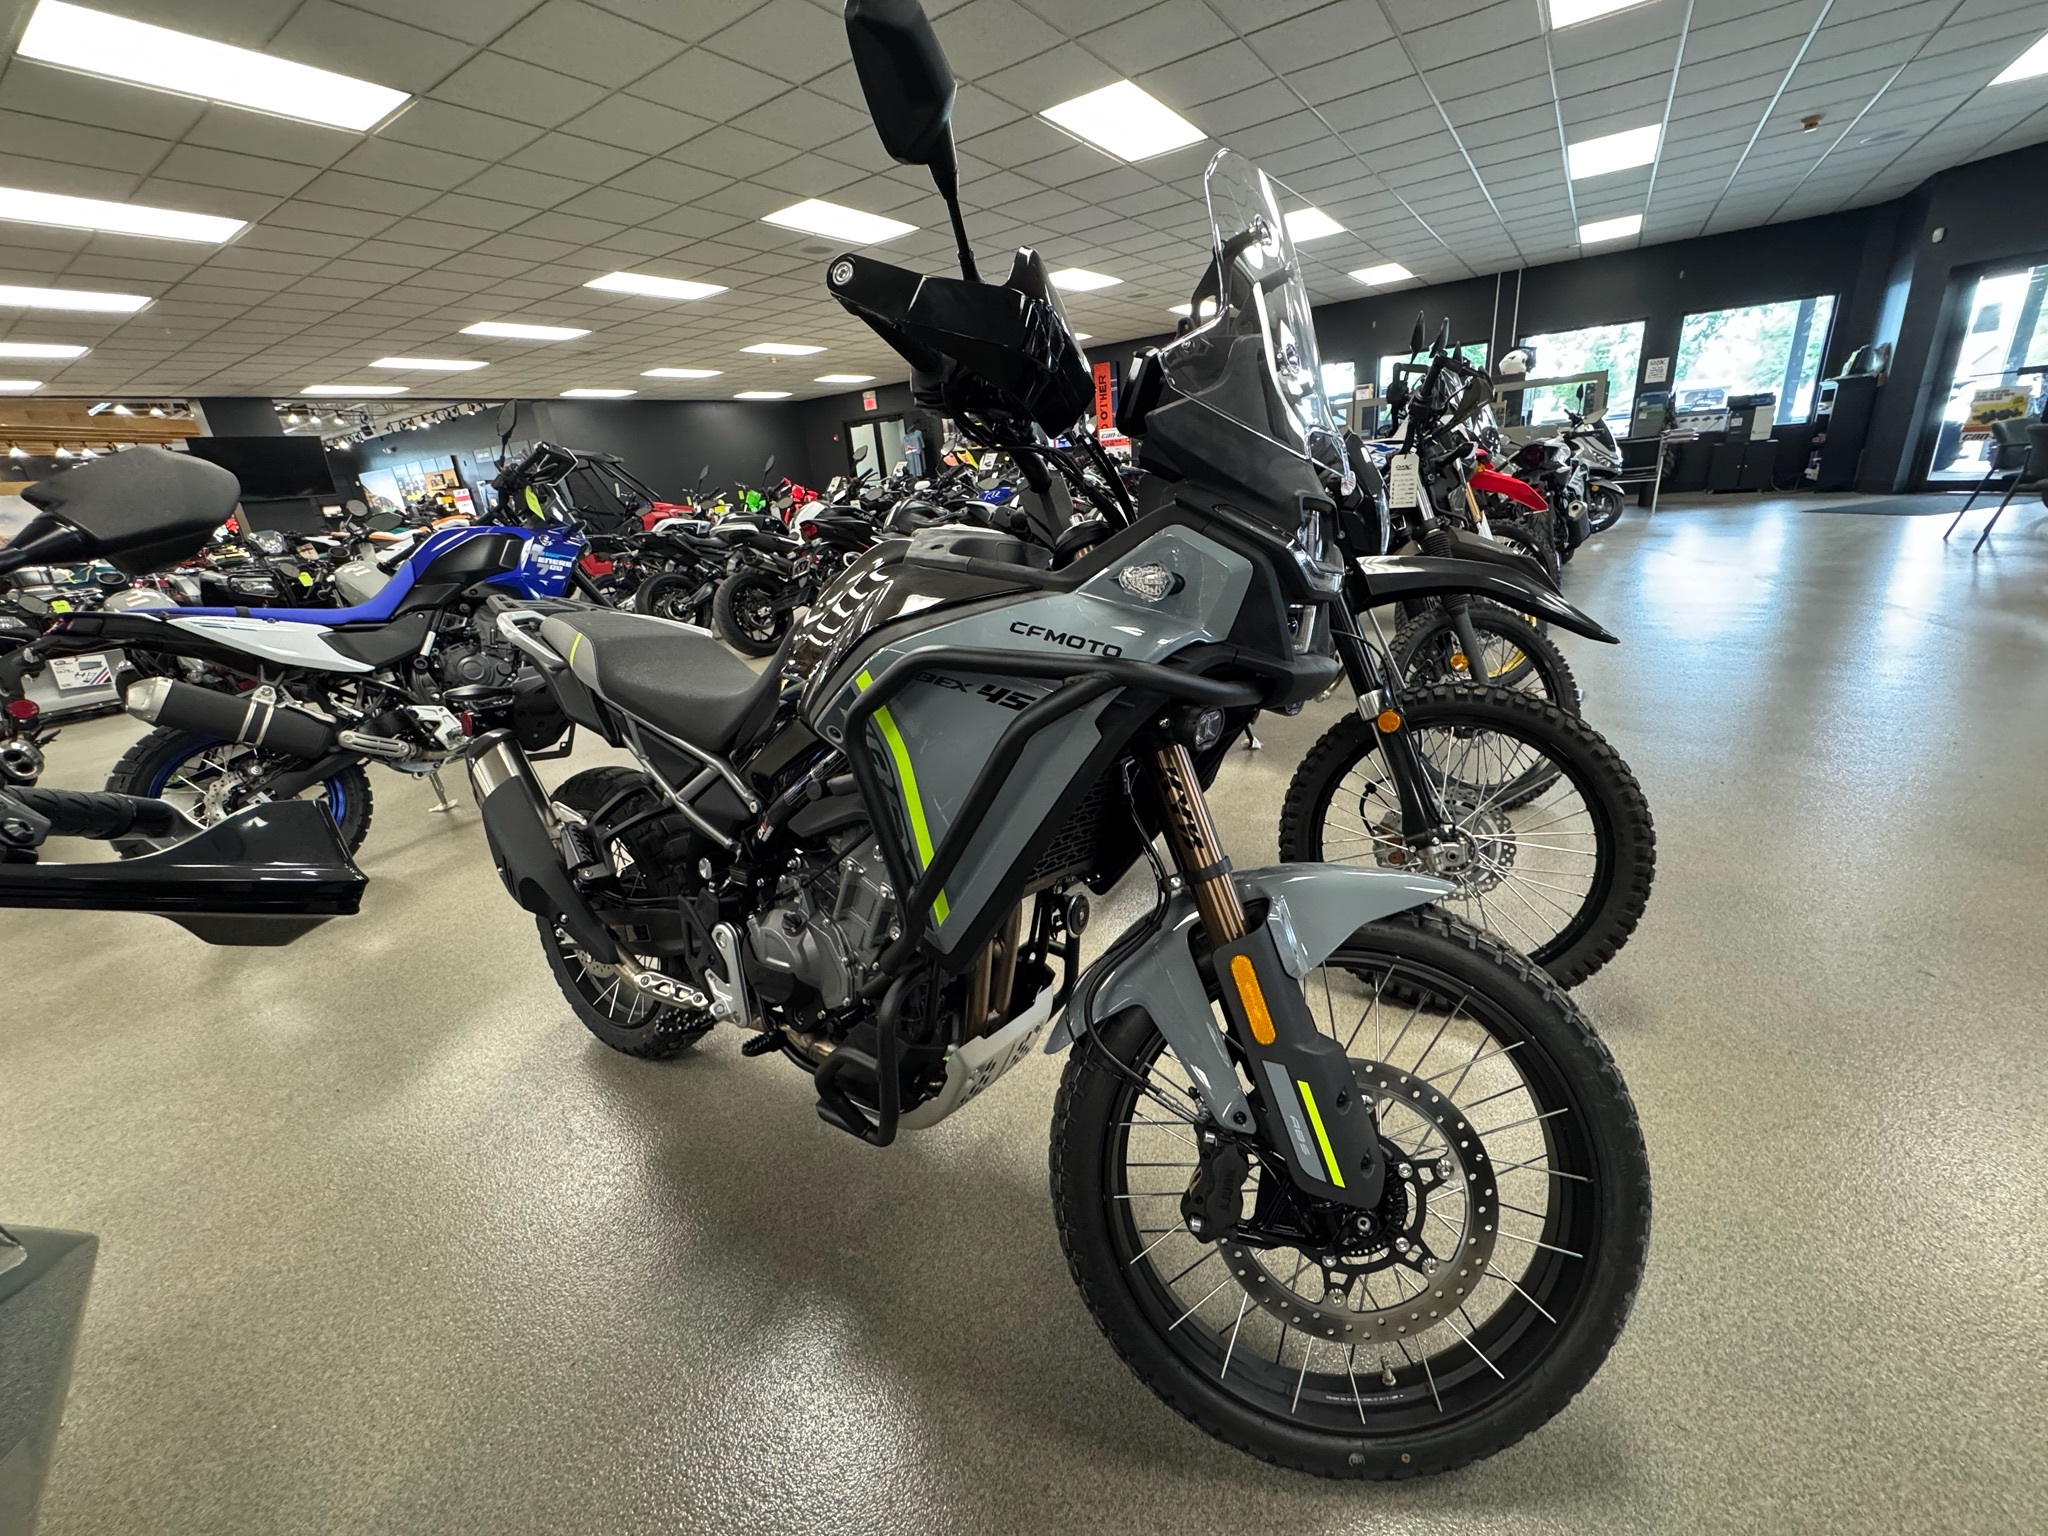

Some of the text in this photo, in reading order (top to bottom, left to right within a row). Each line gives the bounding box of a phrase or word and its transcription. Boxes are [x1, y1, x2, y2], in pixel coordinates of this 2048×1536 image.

[1009, 621, 1123, 658] CFMOTO
[913, 671, 1037, 711] BEX 45
[1289, 1115, 1311, 1157] ABS
